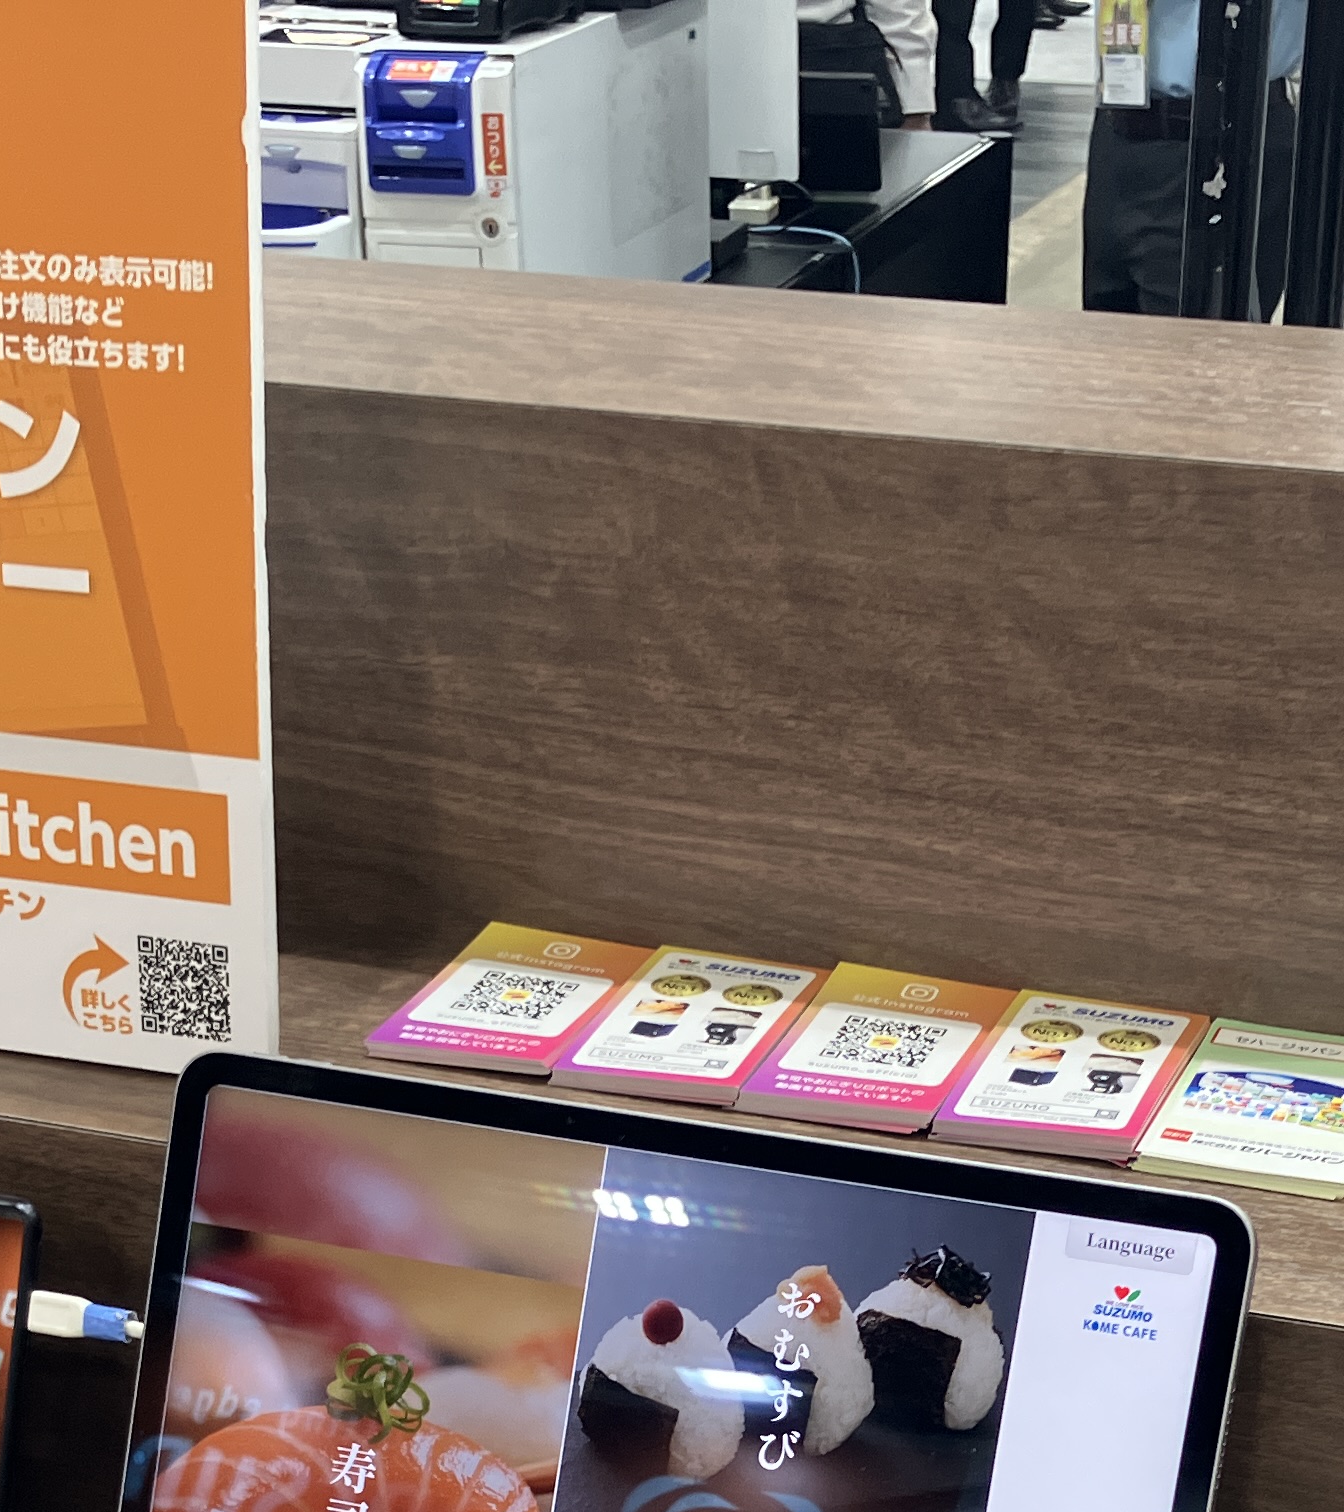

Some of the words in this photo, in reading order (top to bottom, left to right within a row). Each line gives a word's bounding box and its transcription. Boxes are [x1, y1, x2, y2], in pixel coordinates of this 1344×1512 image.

[705, 963, 801, 982] SUZUMO
[80, 988, 132, 1014] 詳しく
[81, 1011, 134, 1036] こちら
[1072, 1007, 1175, 1027] SUZUMO
[598, 1048, 664, 1062] SUZUMO
[980, 1099, 1050, 1112] SUZUMO
[1086, 1232, 1175, 1262] Language
[1093, 1304, 1153, 1323] SUZUMO
[1123, 1325, 1158, 1341] CAFE
[758, 1282, 822, 1472] おむすび
